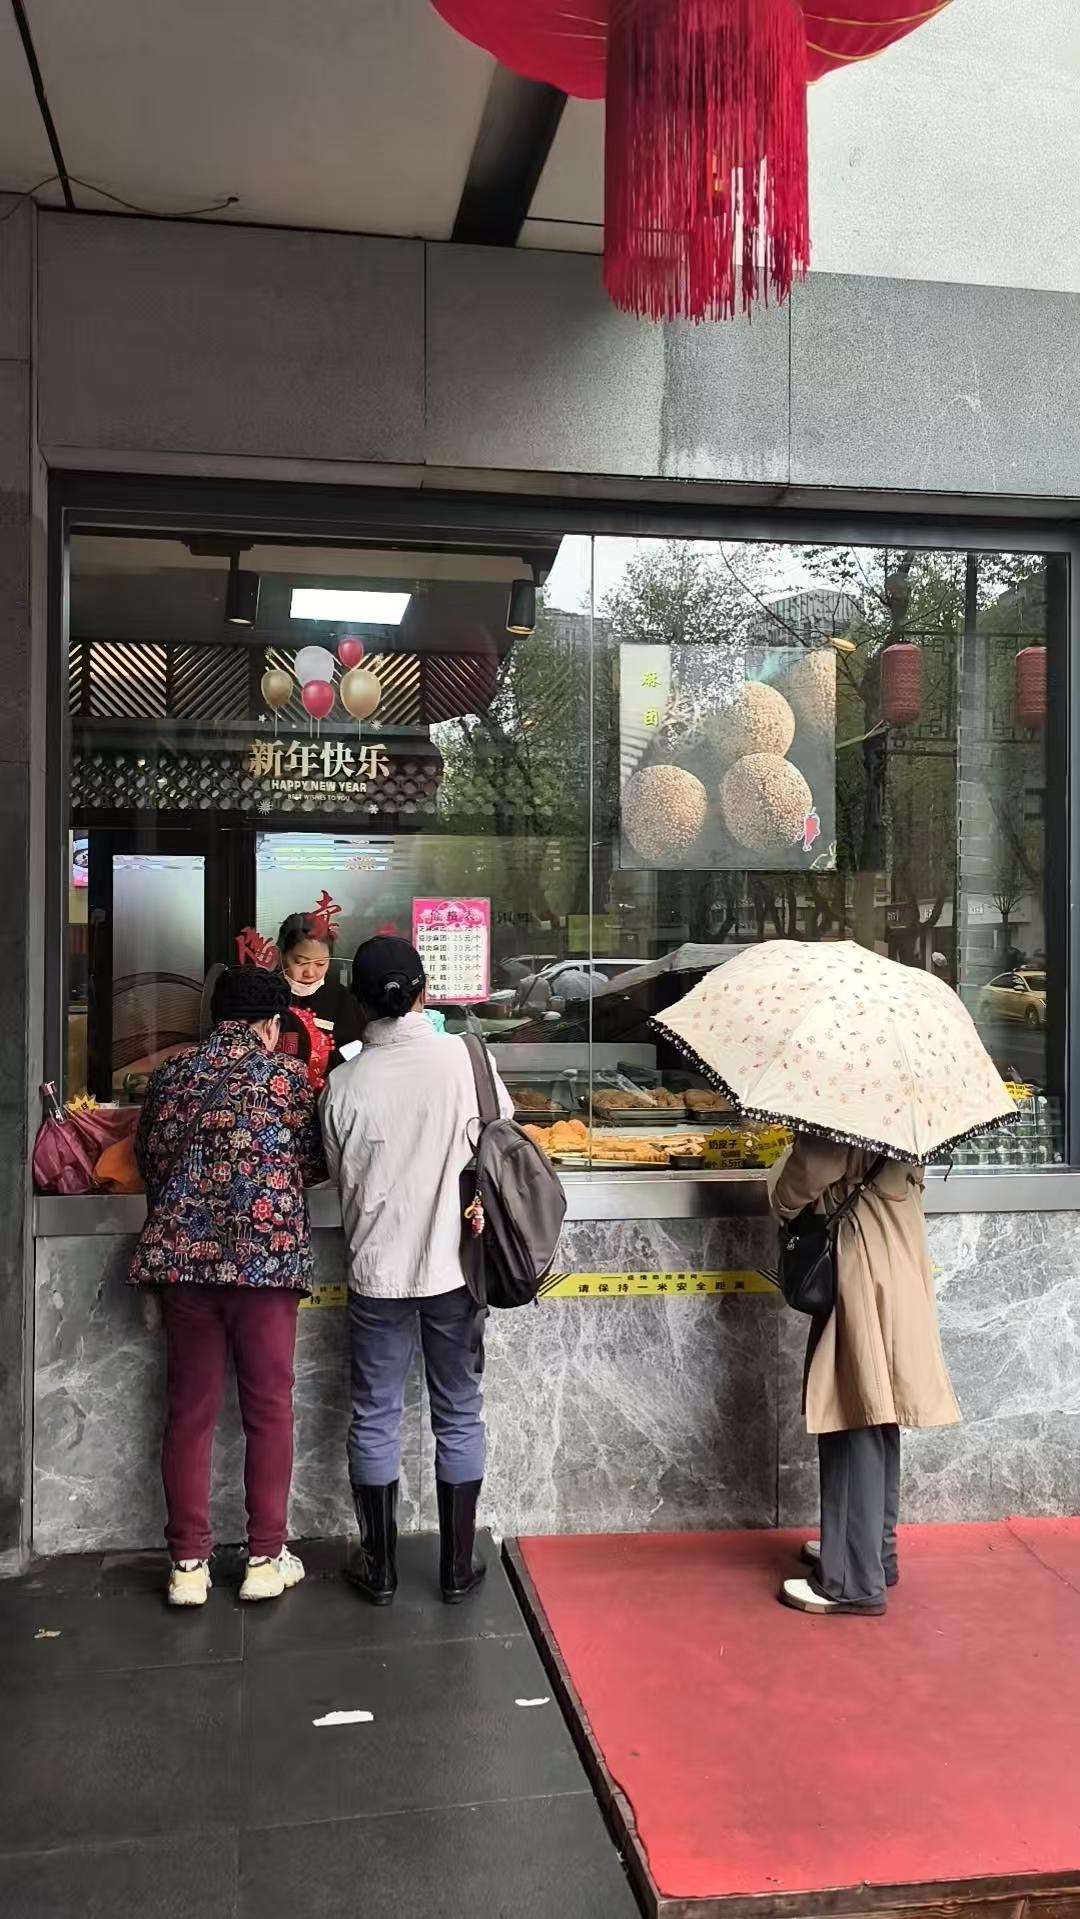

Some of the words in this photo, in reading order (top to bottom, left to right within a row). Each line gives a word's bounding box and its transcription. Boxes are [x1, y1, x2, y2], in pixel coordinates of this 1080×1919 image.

[247, 738, 390, 780] 新年快乐
[271, 779, 309, 791] HAPPY
[311, 780, 336, 792] NEW
[338, 781, 367, 793] YEAR
[577, 1280, 746, 1293] 请保持一米安全距离
